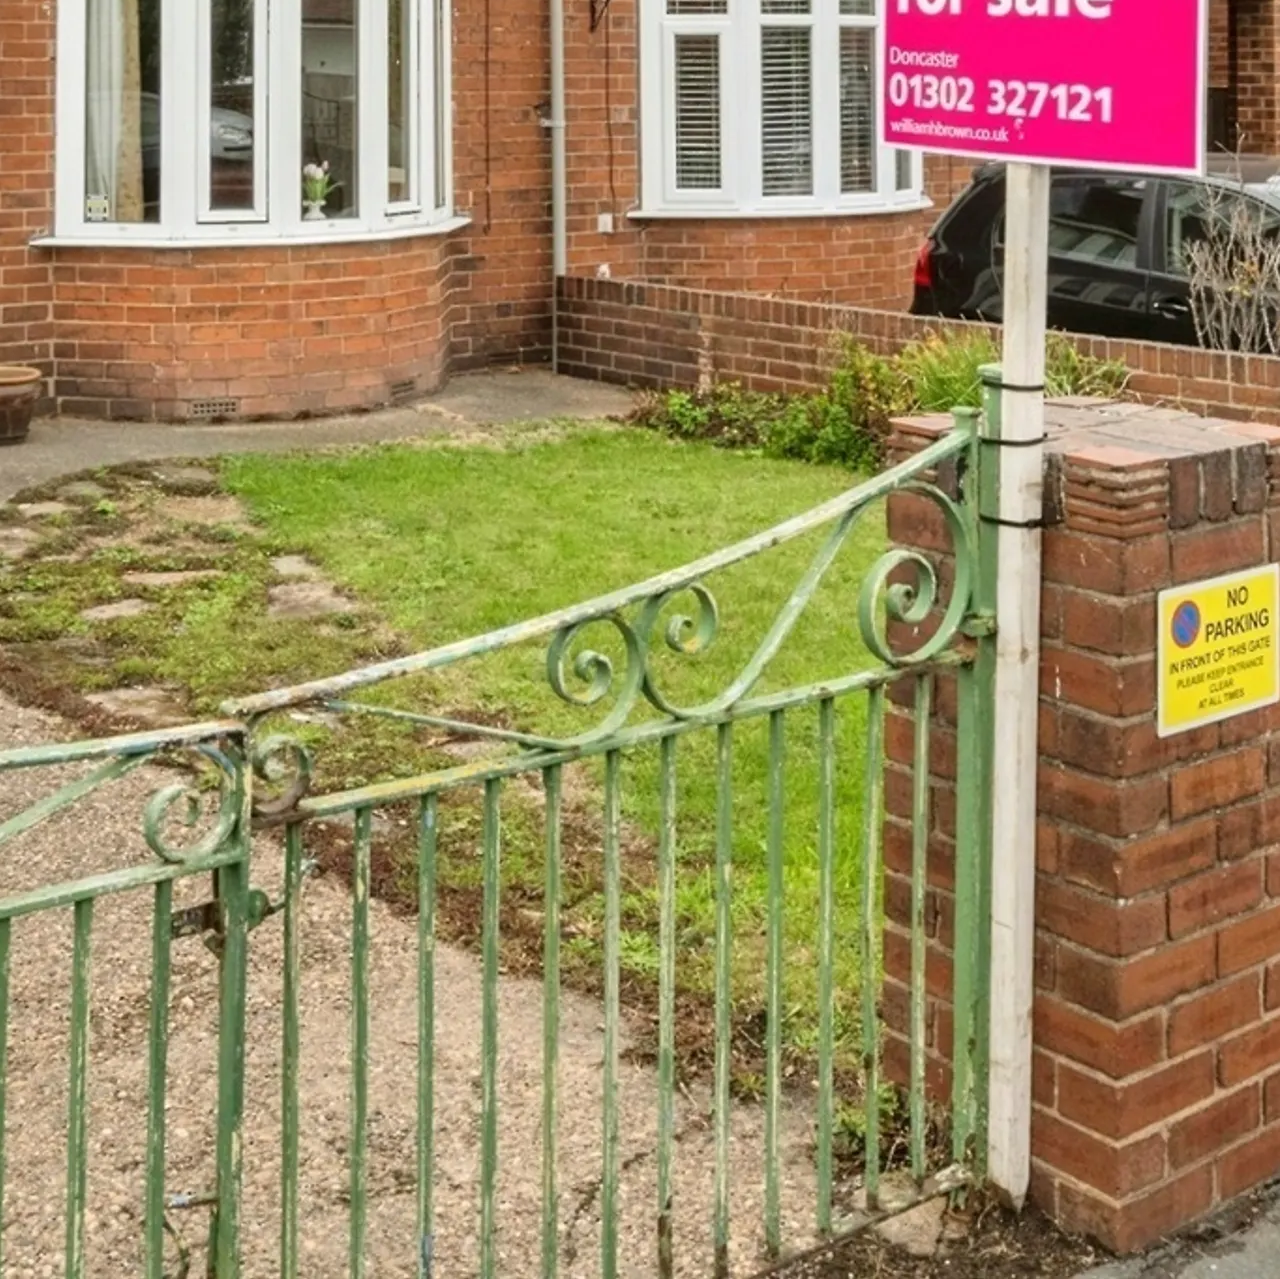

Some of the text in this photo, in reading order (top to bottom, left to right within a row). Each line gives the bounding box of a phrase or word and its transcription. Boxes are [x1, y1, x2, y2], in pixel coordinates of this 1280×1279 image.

[889, 46, 959, 69] Doncaster
[889, 72, 1113, 123] 01302 327121
[890, 118, 1009, 142] williamhbrown.co.uk
[1227, 586, 1249, 608] NO
[1205, 608, 1269, 643] PARKING
[1170, 635, 1270, 676] IN FRONT OF THIS GATE
[1177, 672, 1205, 690] PLEASE
[1207, 666, 1226, 680] KEEP
[1209, 677, 1234, 694] CLEAR
[1224, 688, 1245, 701] TIMES
